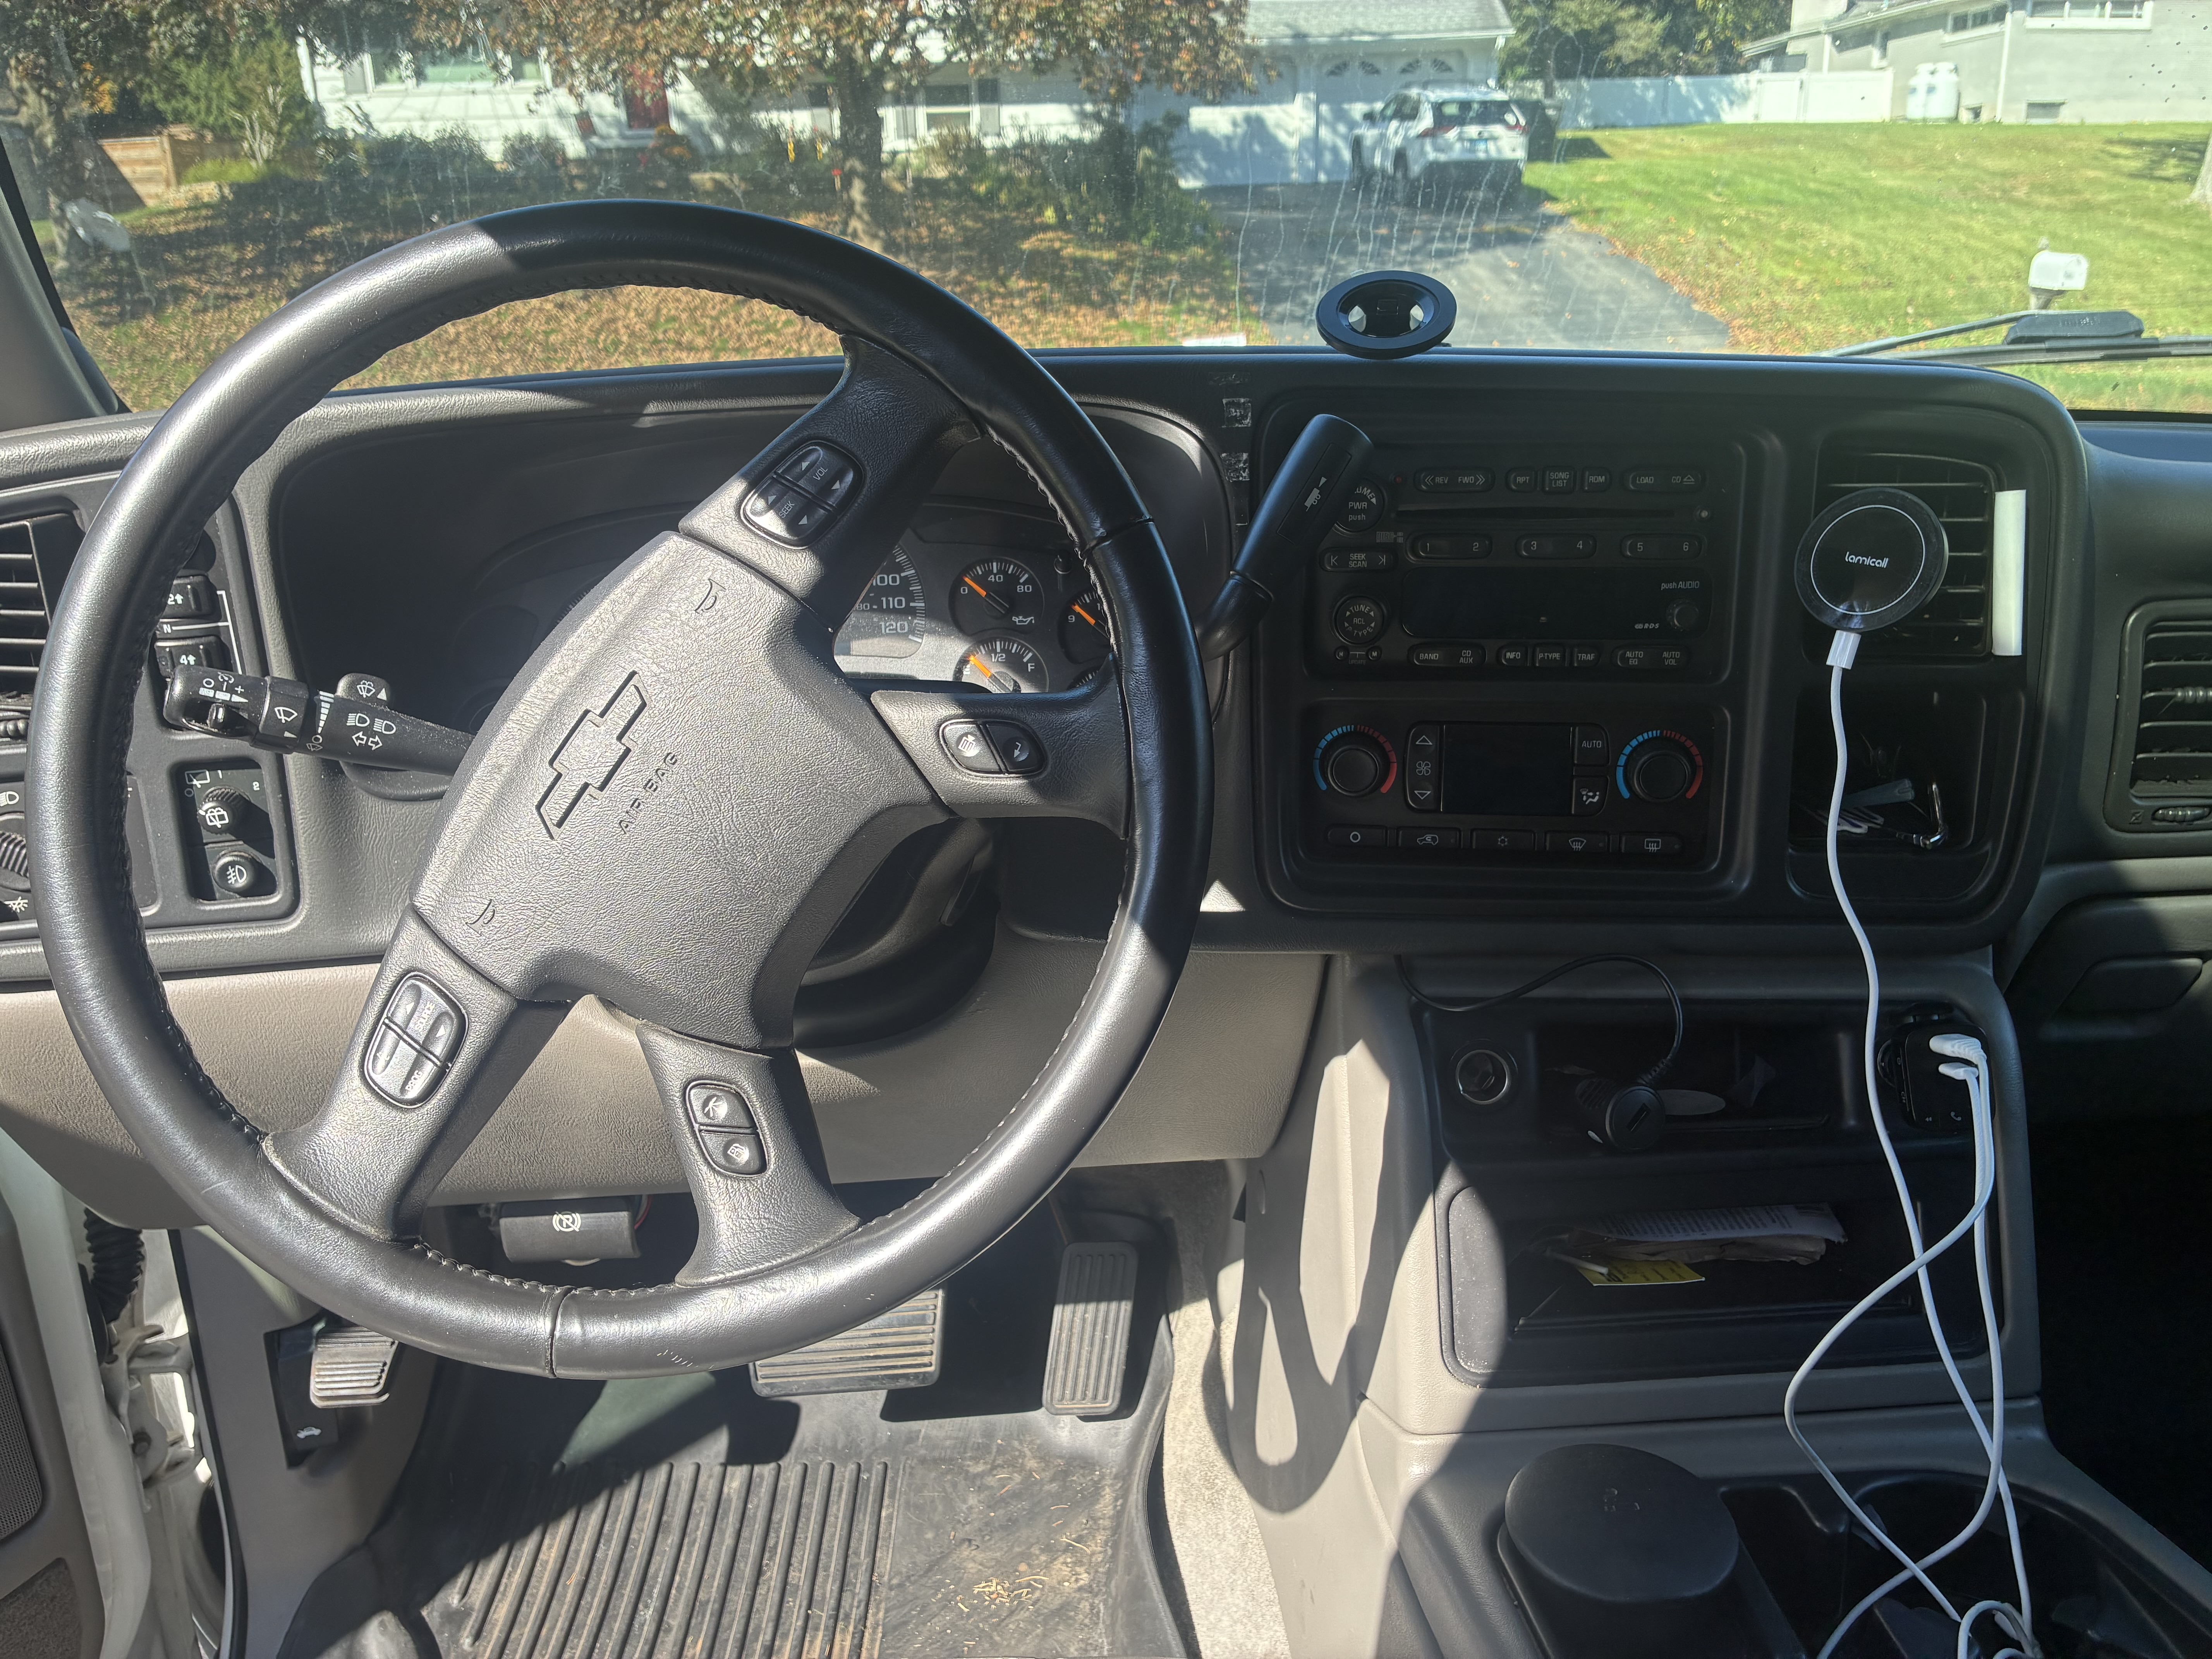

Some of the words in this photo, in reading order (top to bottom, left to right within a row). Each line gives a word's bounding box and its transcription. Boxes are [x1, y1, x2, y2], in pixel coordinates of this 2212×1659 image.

[813, 467, 828, 481] VOL
[778, 500, 795, 519] SEEK
[1348, 513, 1366, 522] push
[1426, 543, 1430, 551] 1
[1472, 543, 1479, 551] 2
[1531, 541, 1537, 550] 3
[1577, 541, 1583, 550] 4
[1637, 543, 1643, 551] 5
[1683, 542, 1689, 551] 6
[1661, 581, 1677, 590] push
[1677, 580, 1700, 589] AUDIO
[881, 597, 905, 609] 110
[1349, 605, 1370, 613] TUNE
[163, 624, 172, 634] N
[879, 621, 908, 634] 120
[1353, 626, 1373, 637] TYPE
[180, 655, 188, 665] 4
[991, 653, 1006, 662] 1/2
[1028, 663, 1035, 672] F
[1582, 739, 1602, 749] AUTO
[619, 797, 646, 835] AIR
[643, 752, 678, 795] BAG
[414, 1001, 435, 1031] SOURCE
[405, 1070, 423, 1092] PROG
